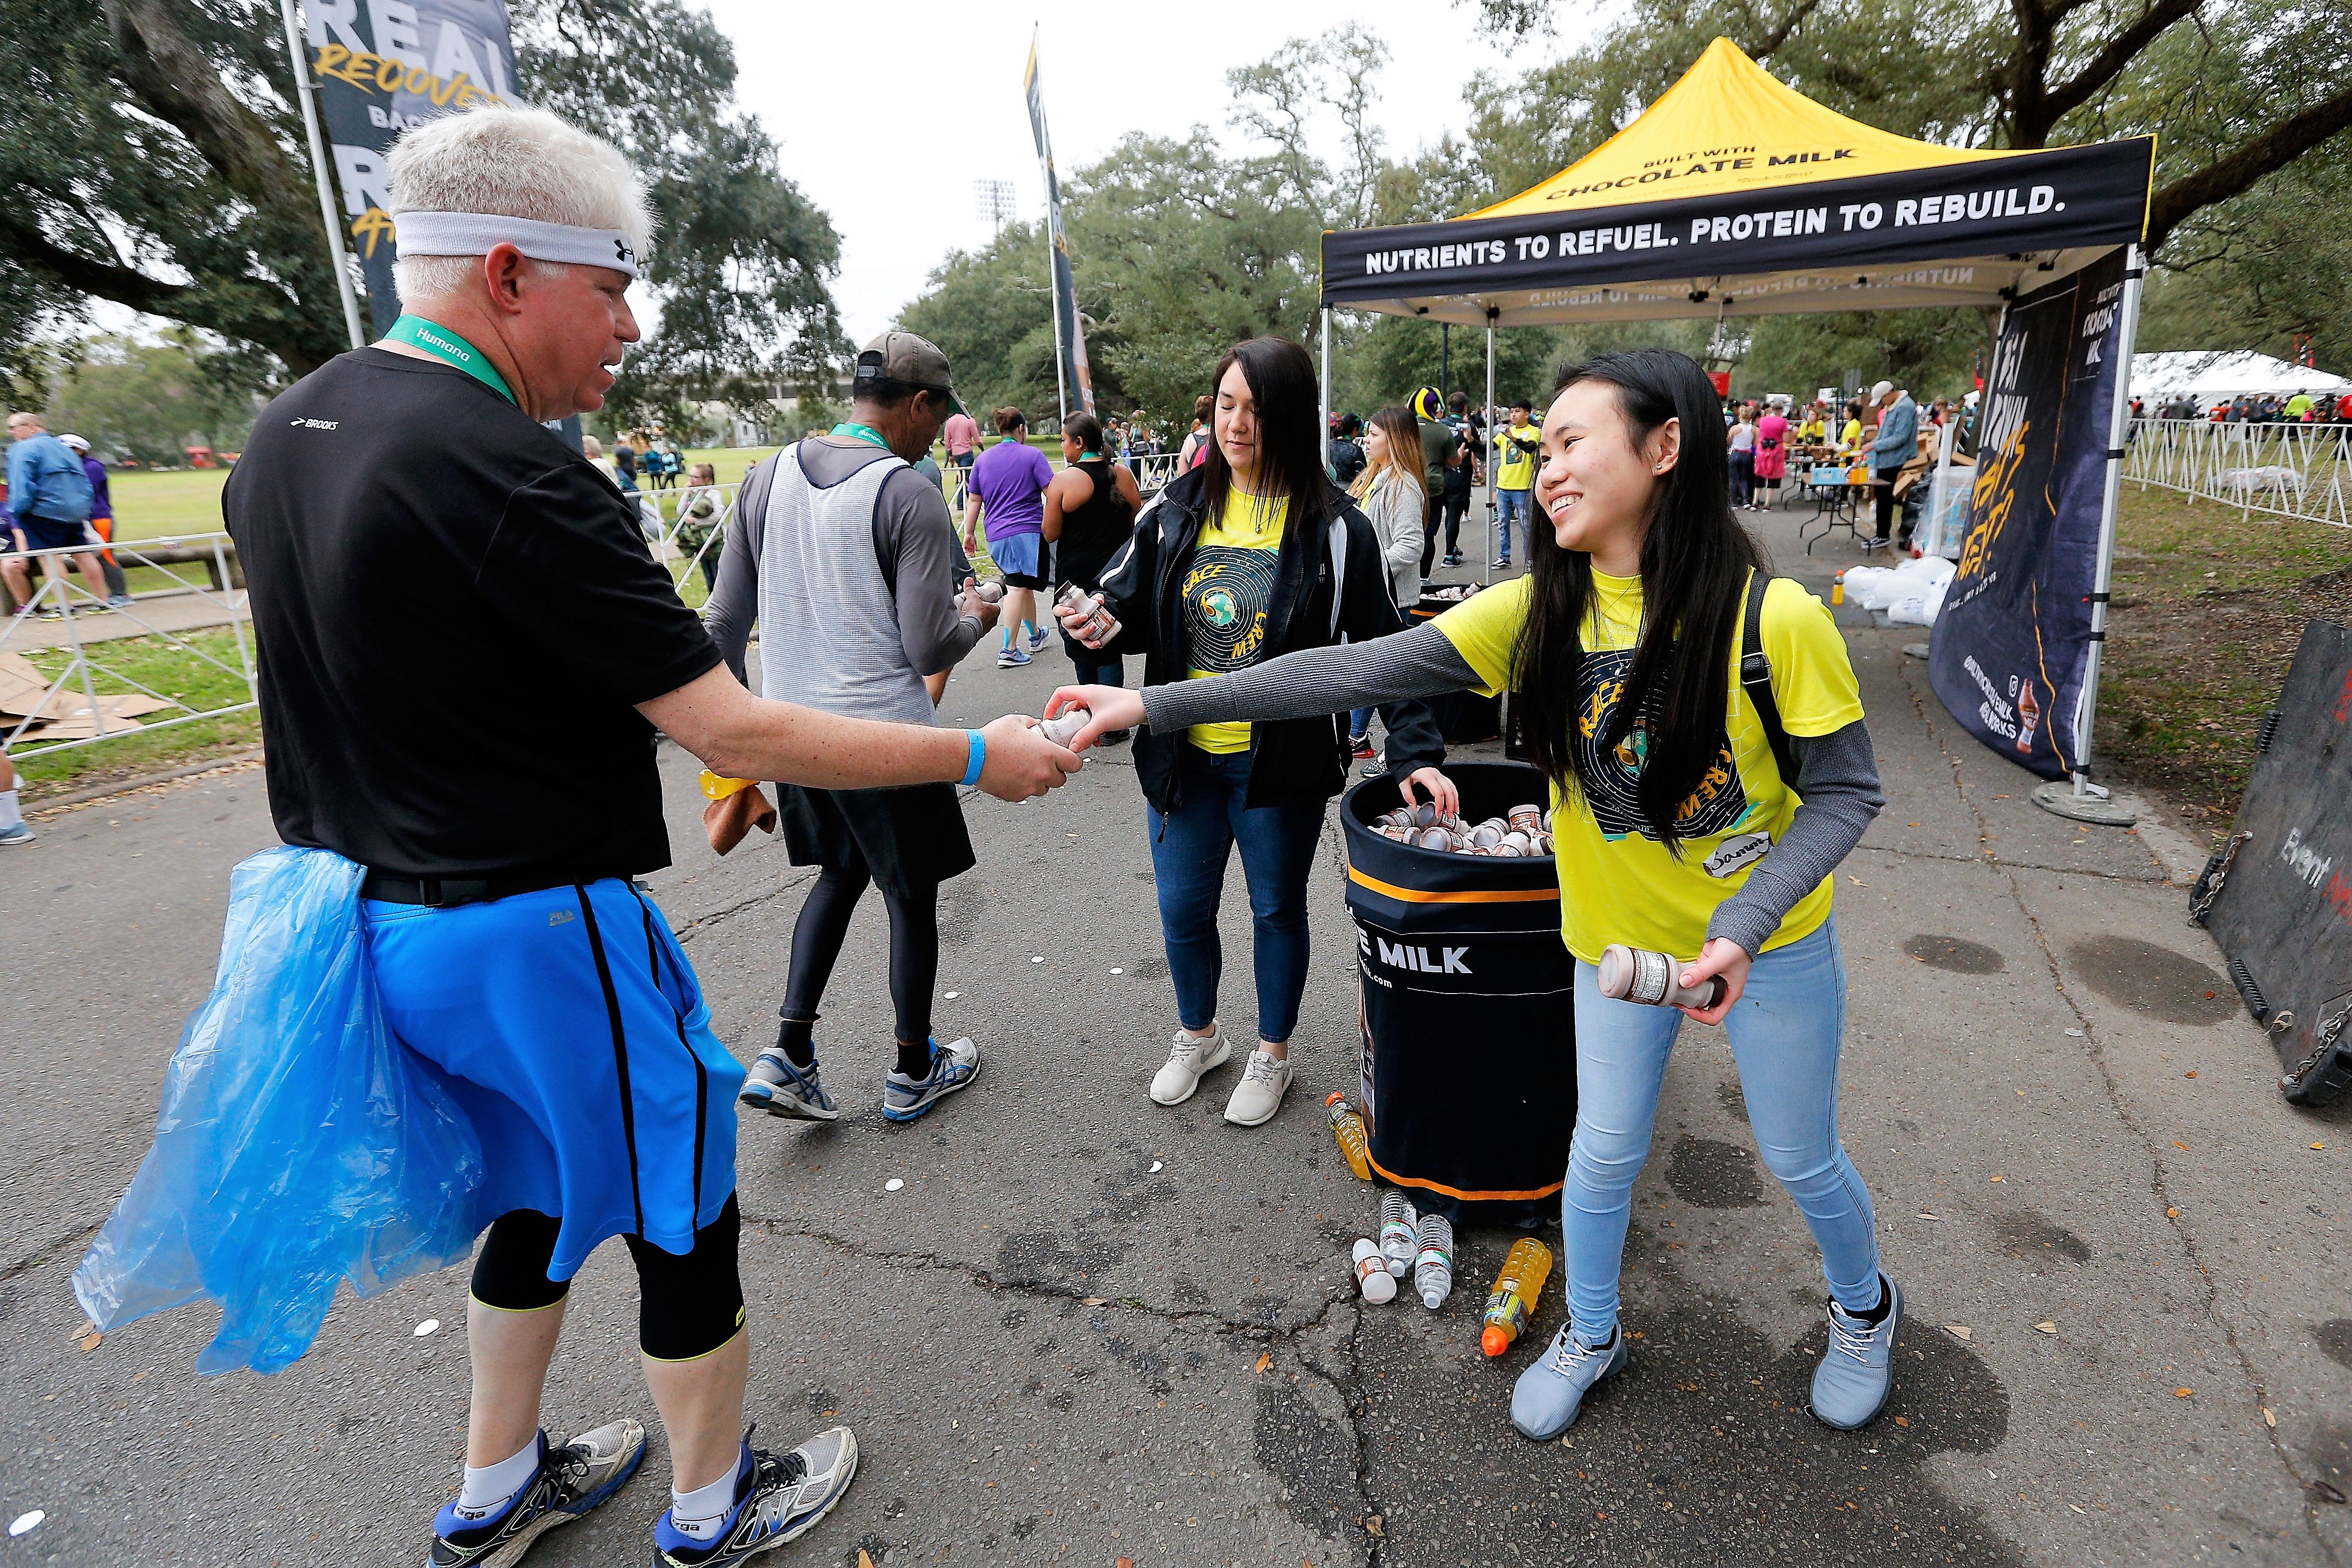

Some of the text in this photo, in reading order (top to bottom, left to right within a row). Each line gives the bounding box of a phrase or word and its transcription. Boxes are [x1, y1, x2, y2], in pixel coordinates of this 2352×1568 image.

[304, 0, 524, 111] REAL
[313, 43, 505, 107] RECOVE
[1546, 157, 1755, 200] CHOCOLATE
[1769, 148, 1858, 166] MILK
[1644, 146, 1755, 168] BUILT WITH
[1366, 185, 2065, 274] NUTRIENTS TO REFUEL. PROTEIN TO REBUILD.
[416, 326, 471, 363] Humana
[305, 418, 339, 430] BROOKS
[858, 429, 884, 445] Humana
[1203, 654, 1214, 665] TOUR
[549, 909, 573, 922] FILA
[1377, 937, 1473, 974] MILK
